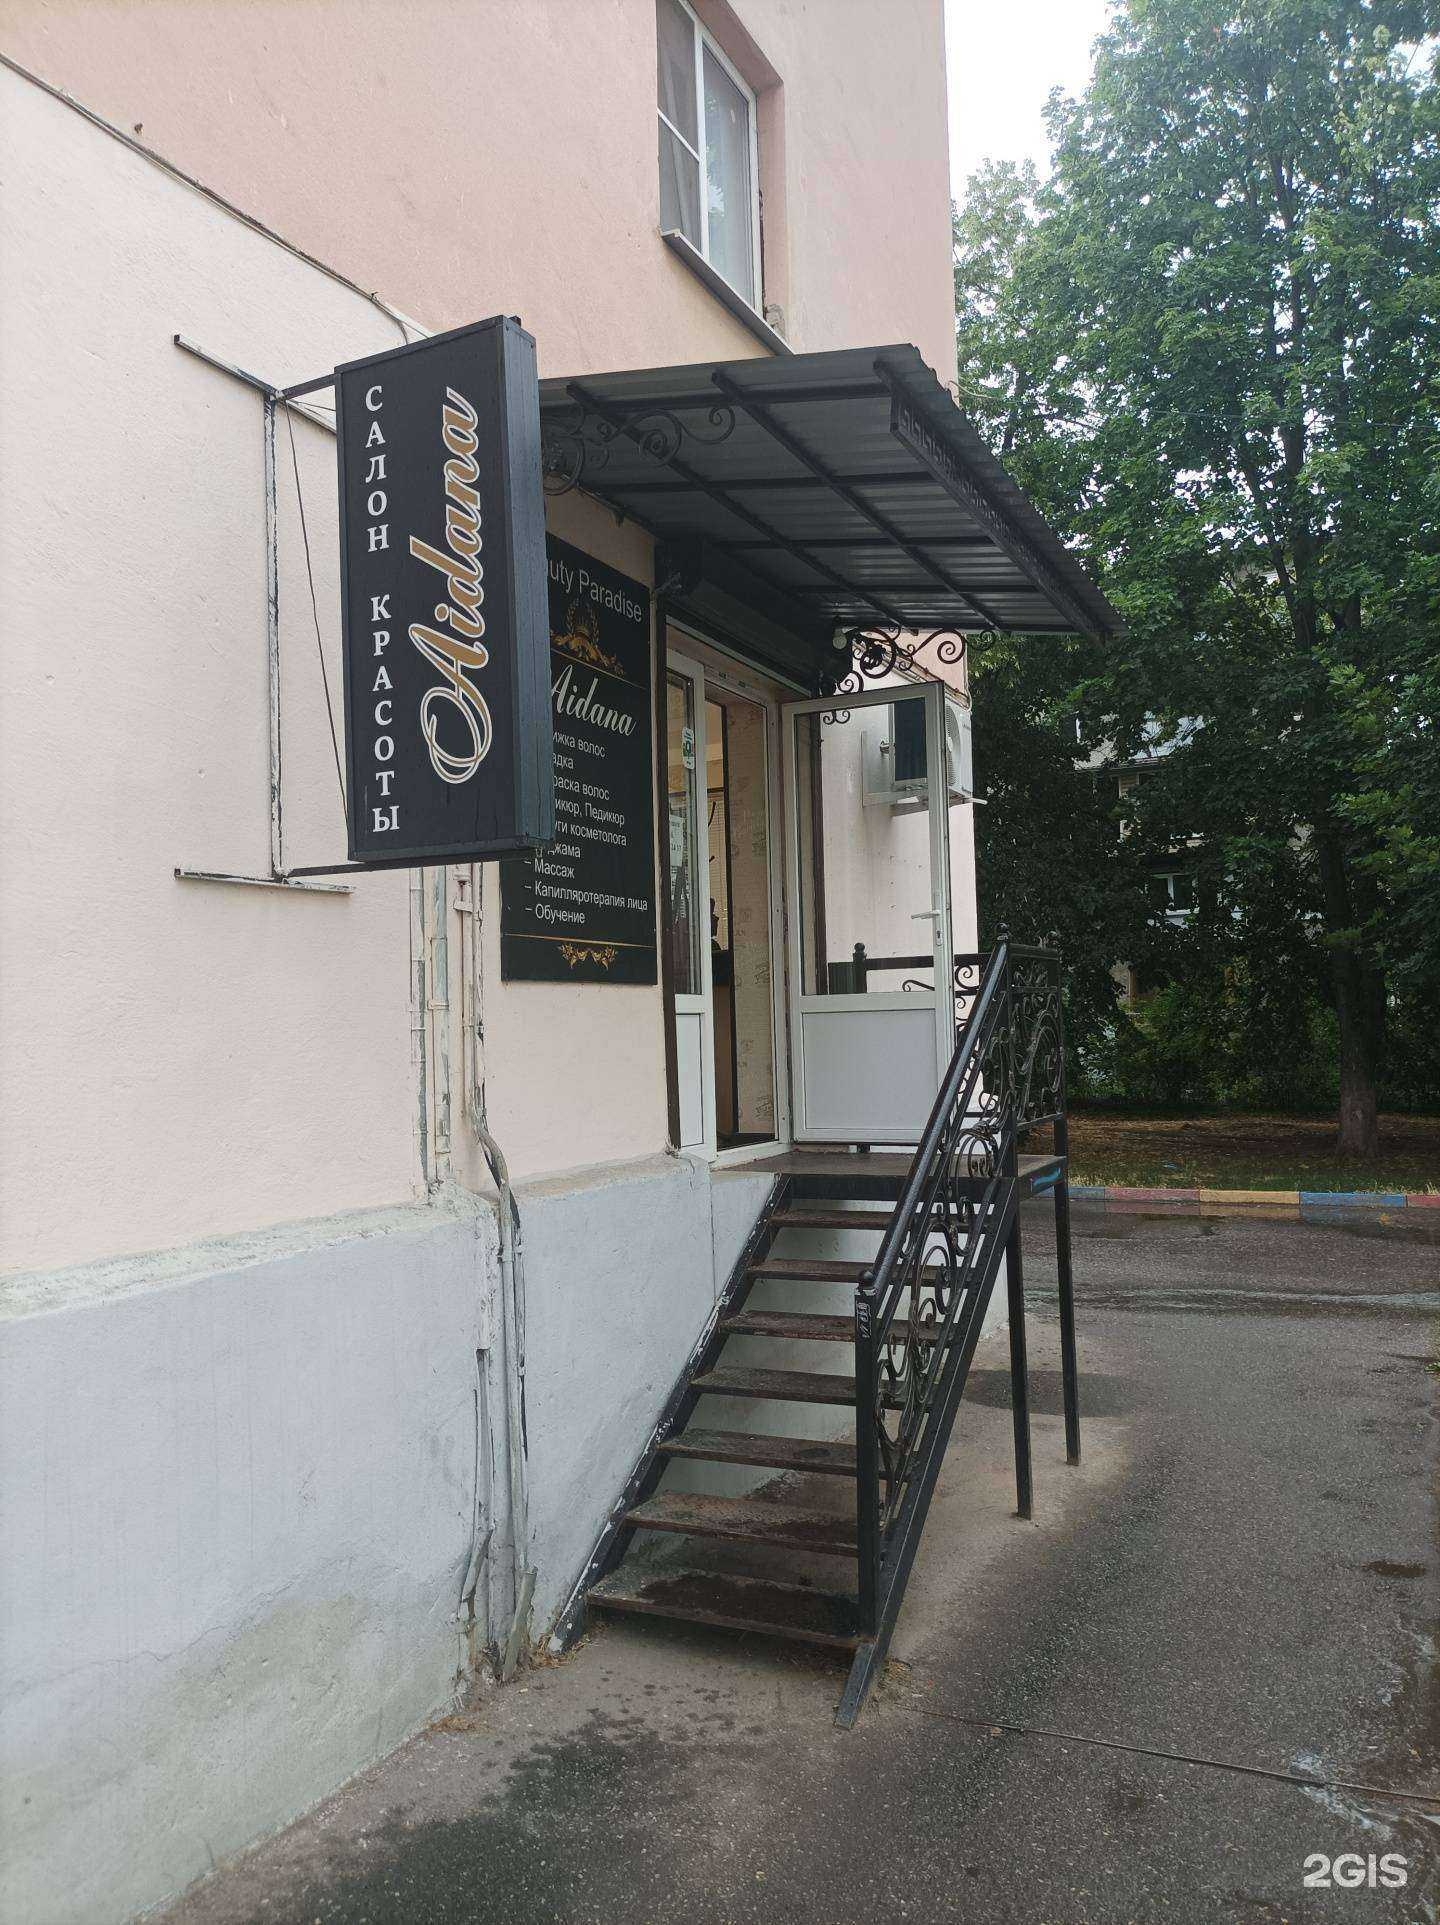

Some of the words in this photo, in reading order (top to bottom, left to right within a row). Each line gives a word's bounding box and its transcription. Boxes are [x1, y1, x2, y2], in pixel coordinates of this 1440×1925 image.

[364, 384, 390, 554] САЛОН
[408, 386, 493, 784] Aidana
[549, 559, 574, 593] uty
[580, 569, 642, 623] Paradise
[551, 664, 636, 736] Aidana
[370, 594, 400, 834] КРАСОТЫ
[553, 731, 575, 748] ижка
[578, 739, 605, 757] волос
[553, 752, 574, 769] адка
[553, 775, 580, 793] раска
[582, 783, 610, 801] волос
[585, 802, 625, 828] Педикюр
[570, 823, 627, 846] косметолога
[534, 858, 575, 879] Массаж
[535, 880, 625, 908] Капилляротерапия
[627, 897, 648, 911] лица
[535, 903, 586, 924] Обучение
